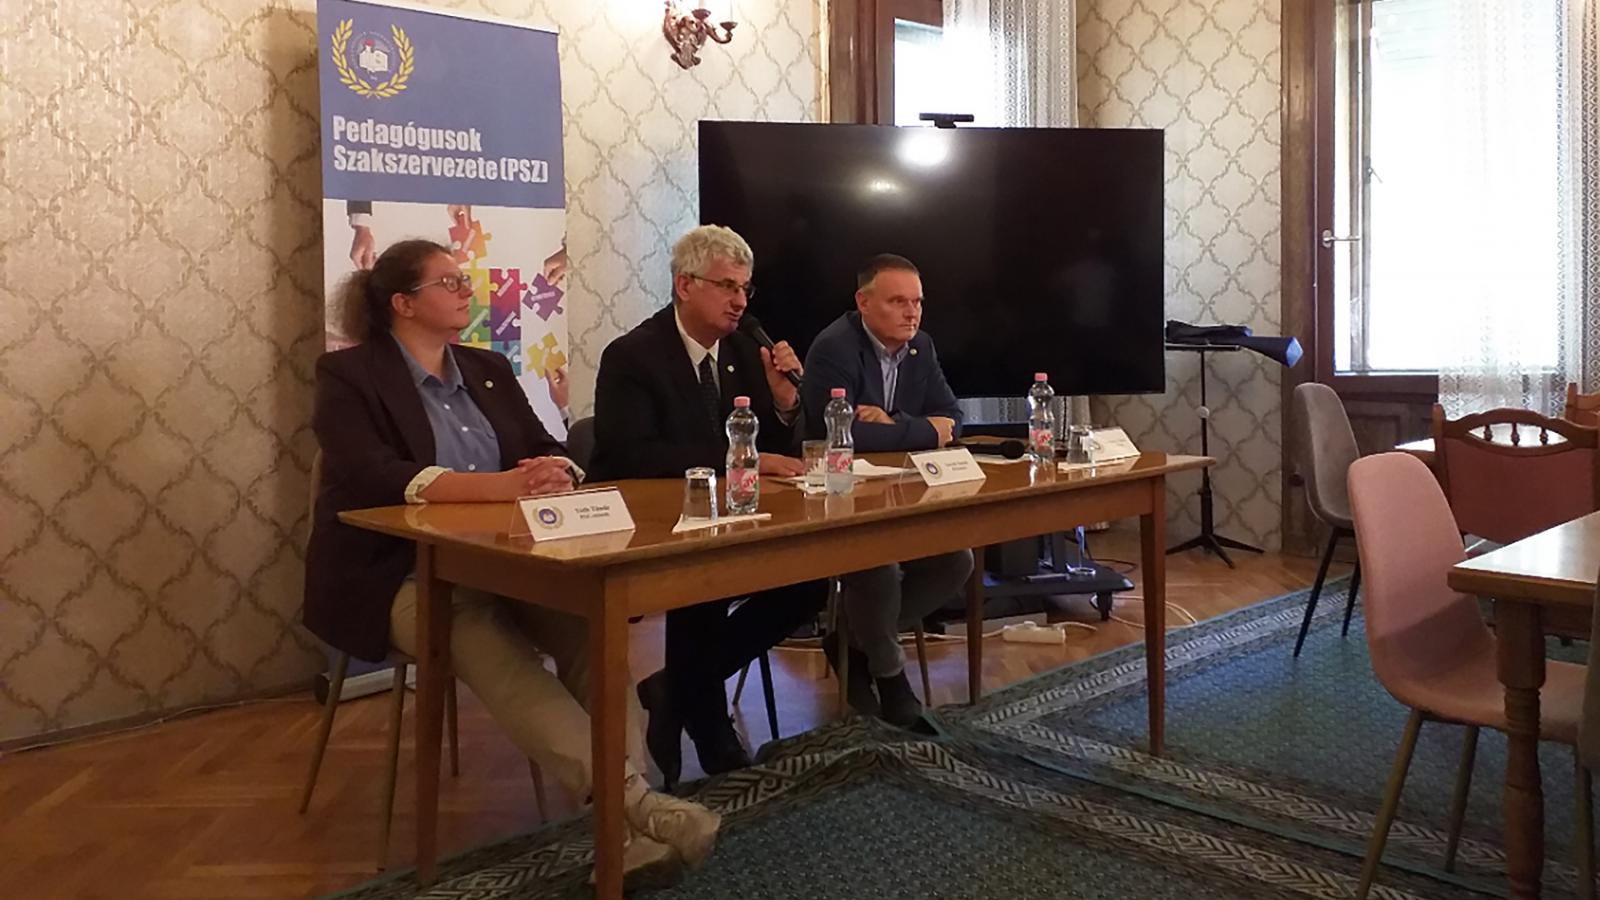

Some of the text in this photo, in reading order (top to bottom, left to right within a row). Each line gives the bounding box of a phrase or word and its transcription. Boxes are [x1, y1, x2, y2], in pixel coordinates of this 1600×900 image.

[333, 115, 482, 152] Pedagógusok
[334, 145, 549, 183] Szakszervezete (PSZ)
